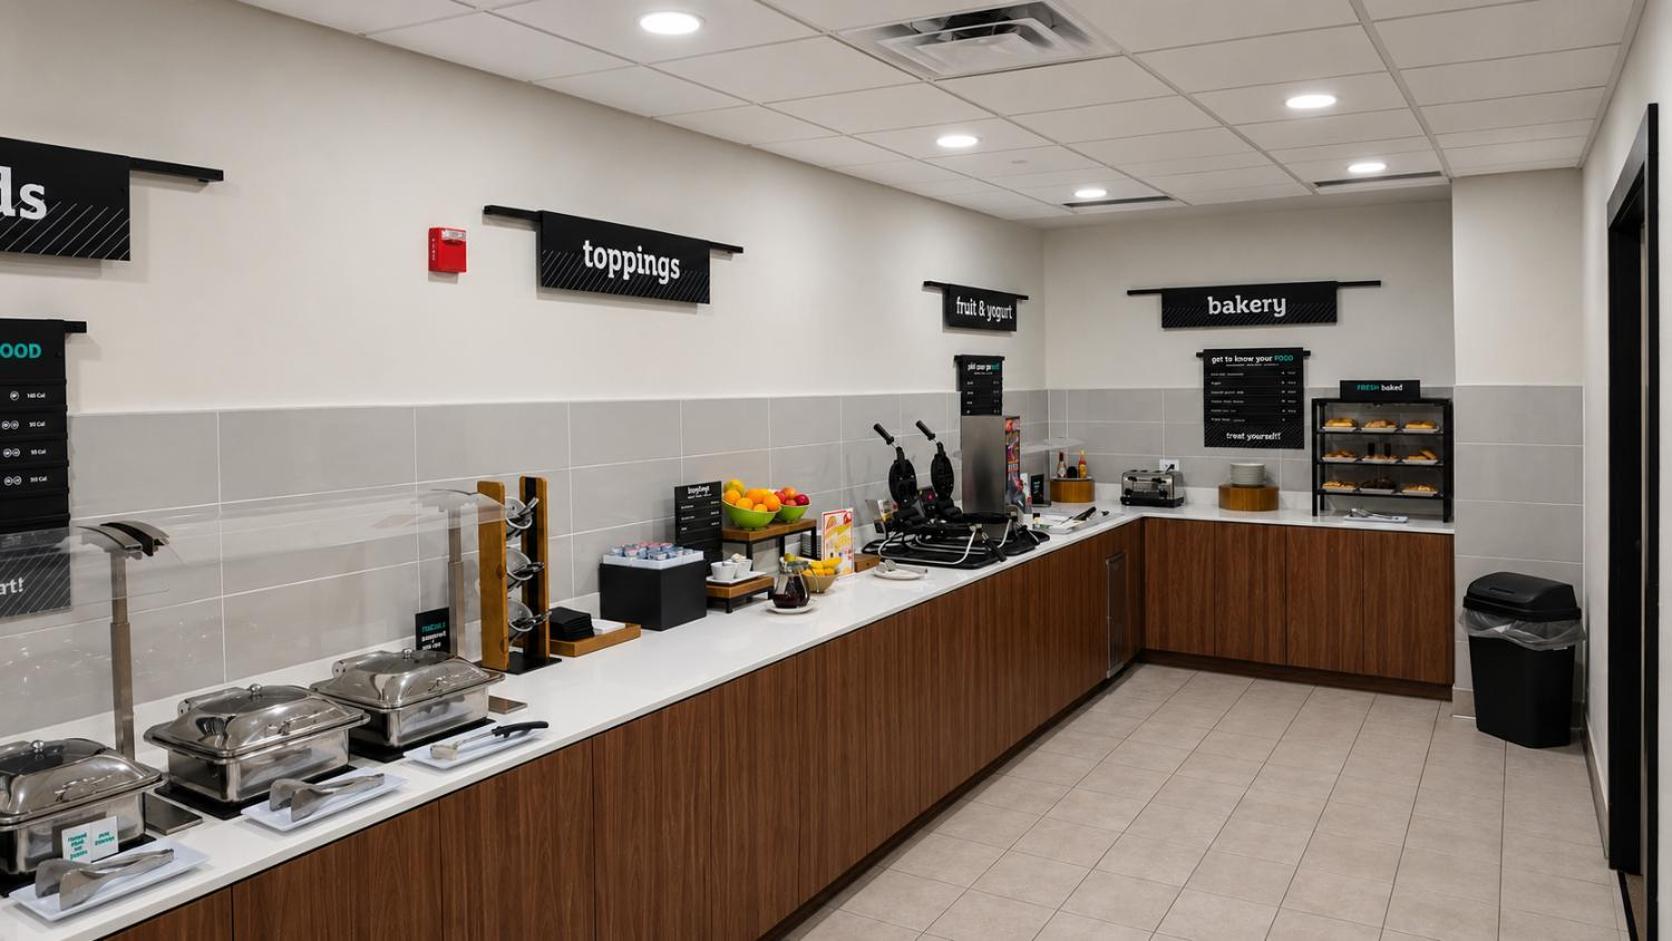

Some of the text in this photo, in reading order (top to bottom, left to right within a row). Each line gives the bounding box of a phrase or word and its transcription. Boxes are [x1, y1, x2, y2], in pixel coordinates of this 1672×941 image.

[583, 240, 680, 285] toppings
[956, 296, 1013, 322] fruit & yogurt
[1207, 294, 1286, 317] bakery
[1211, 356, 1224, 364] get
[1234, 355, 1254, 363] know
